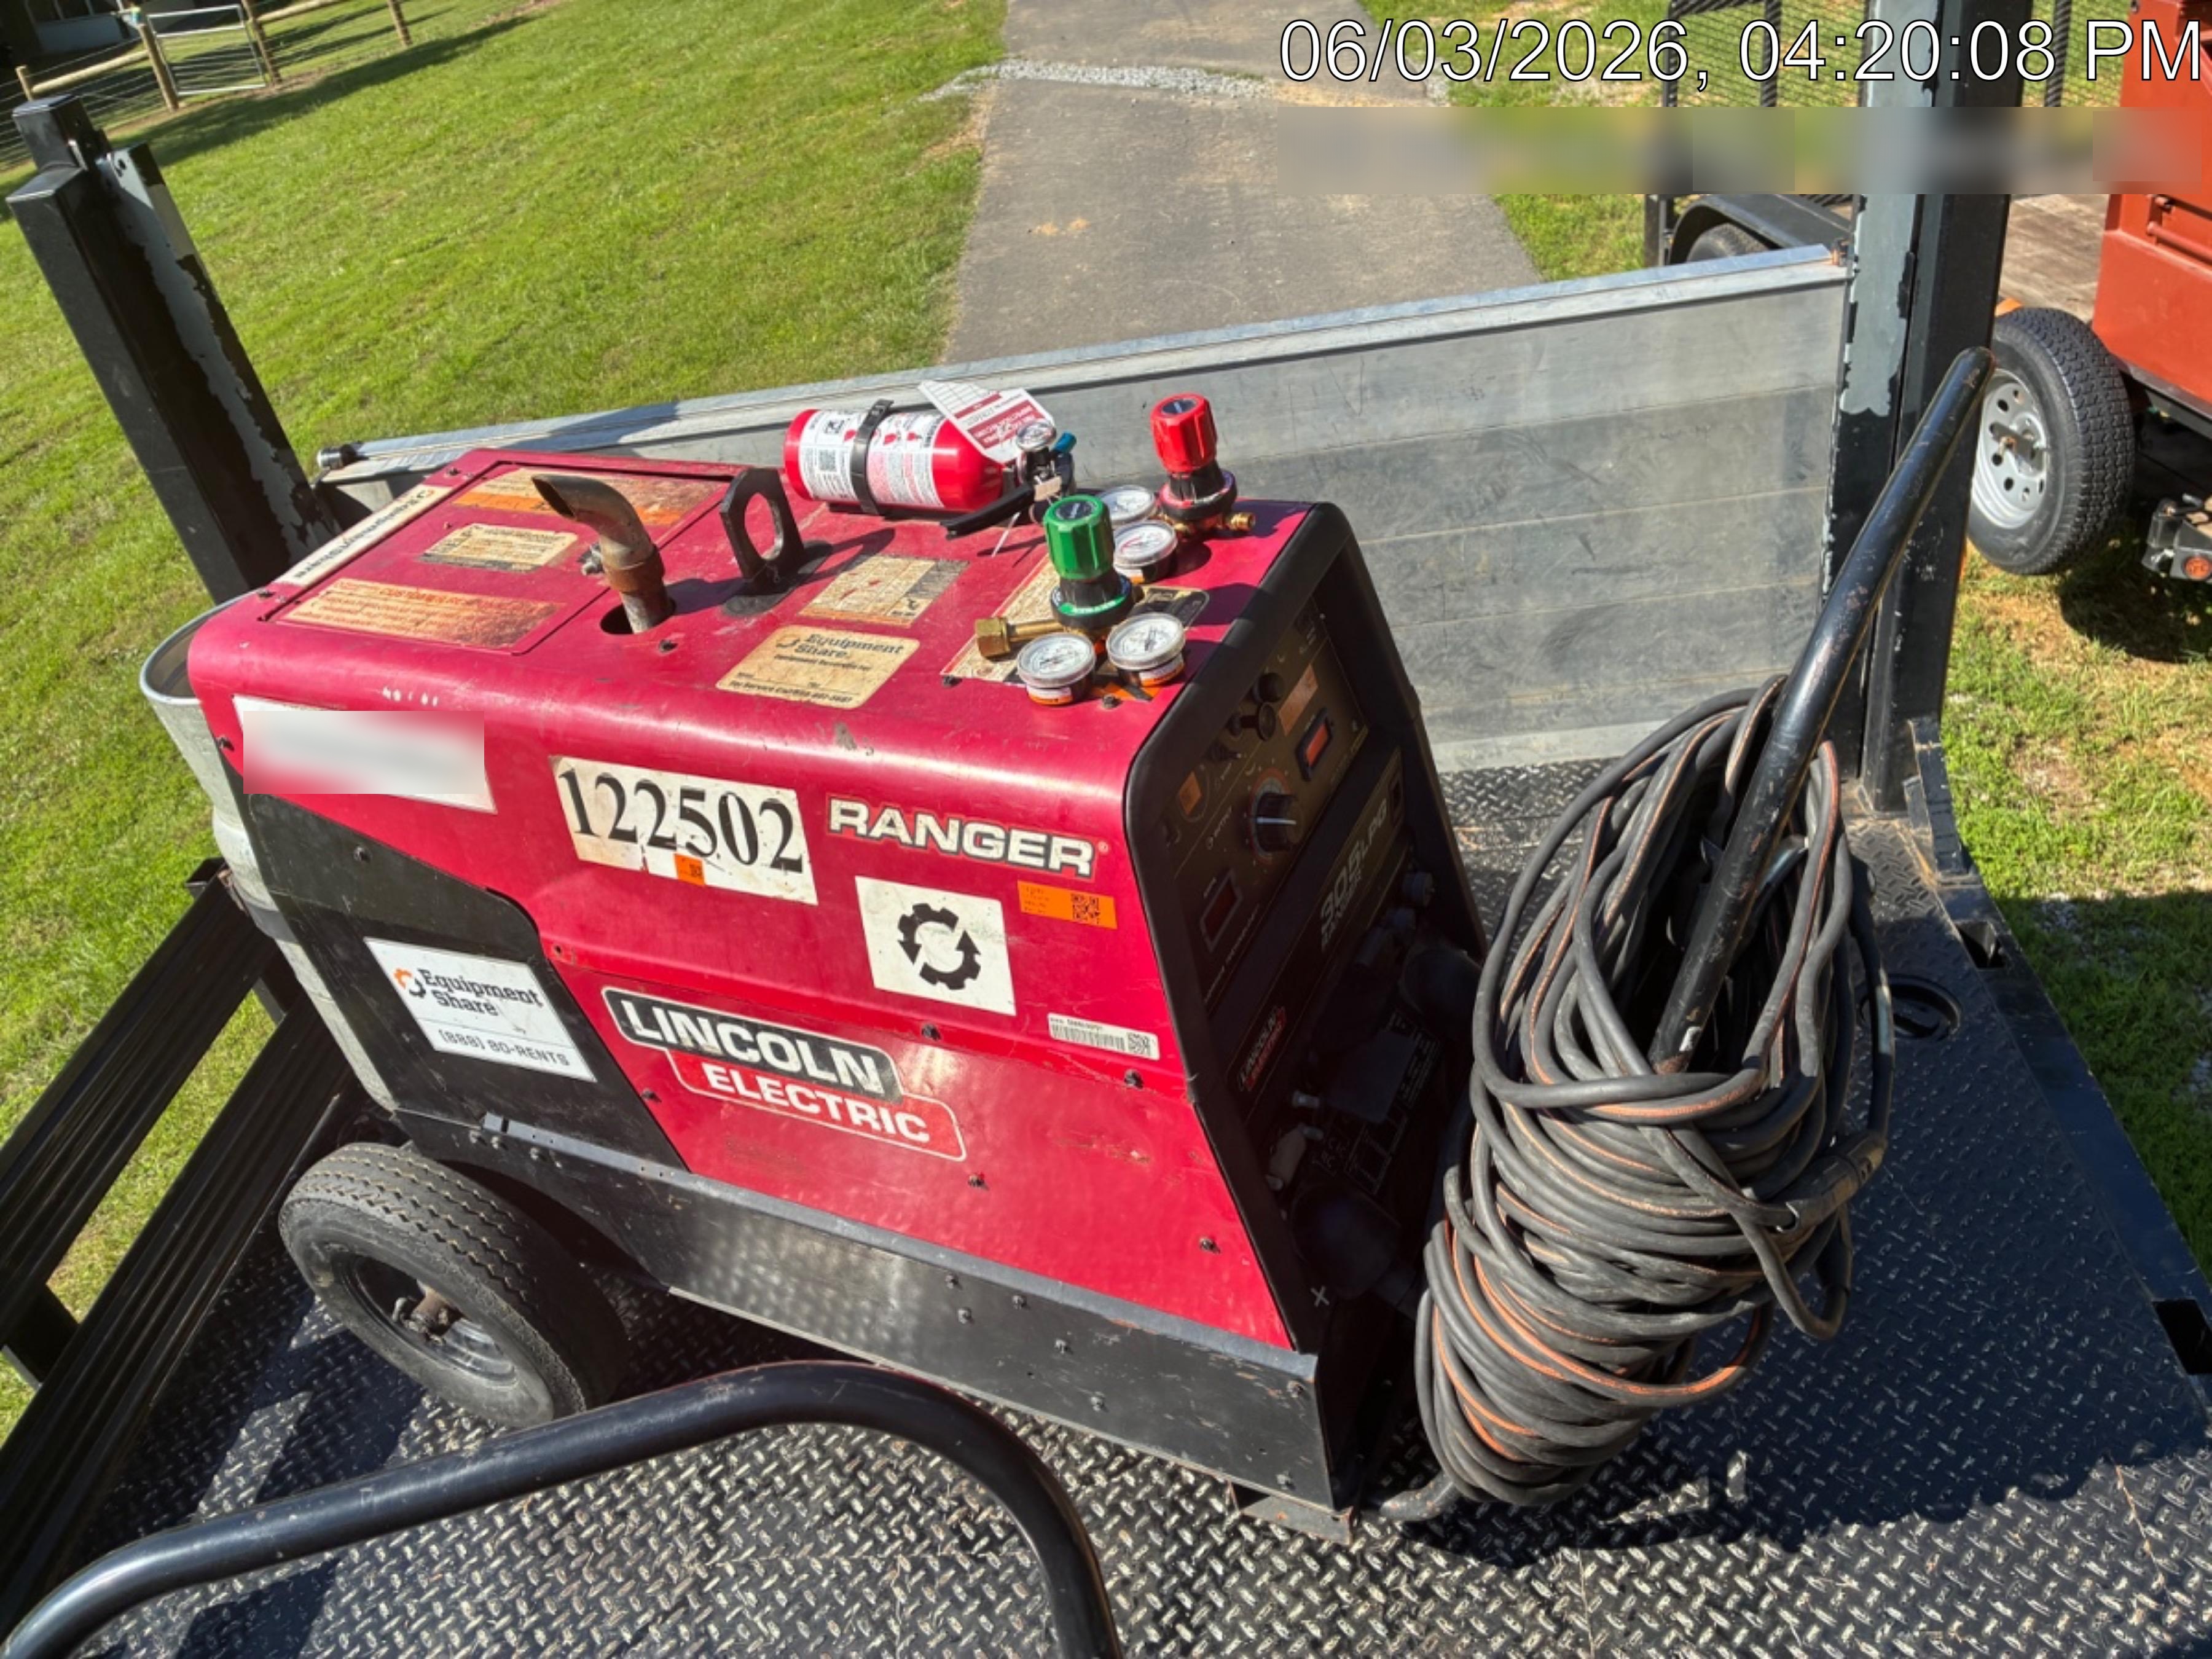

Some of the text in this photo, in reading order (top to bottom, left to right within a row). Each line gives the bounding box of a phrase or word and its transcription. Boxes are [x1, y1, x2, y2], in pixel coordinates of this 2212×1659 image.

[805, 633, 904, 654] Equipment
[559, 767, 804, 874] 122502
[828, 797, 1095, 878] RANGER
[417, 968, 545, 1008] Equipment
[431, 989, 500, 1018] Share
[437, 1028, 485, 1051] (888)
[619, 998, 886, 1095] LINCOLN
[701, 1062, 931, 1144] ELECTRIC
